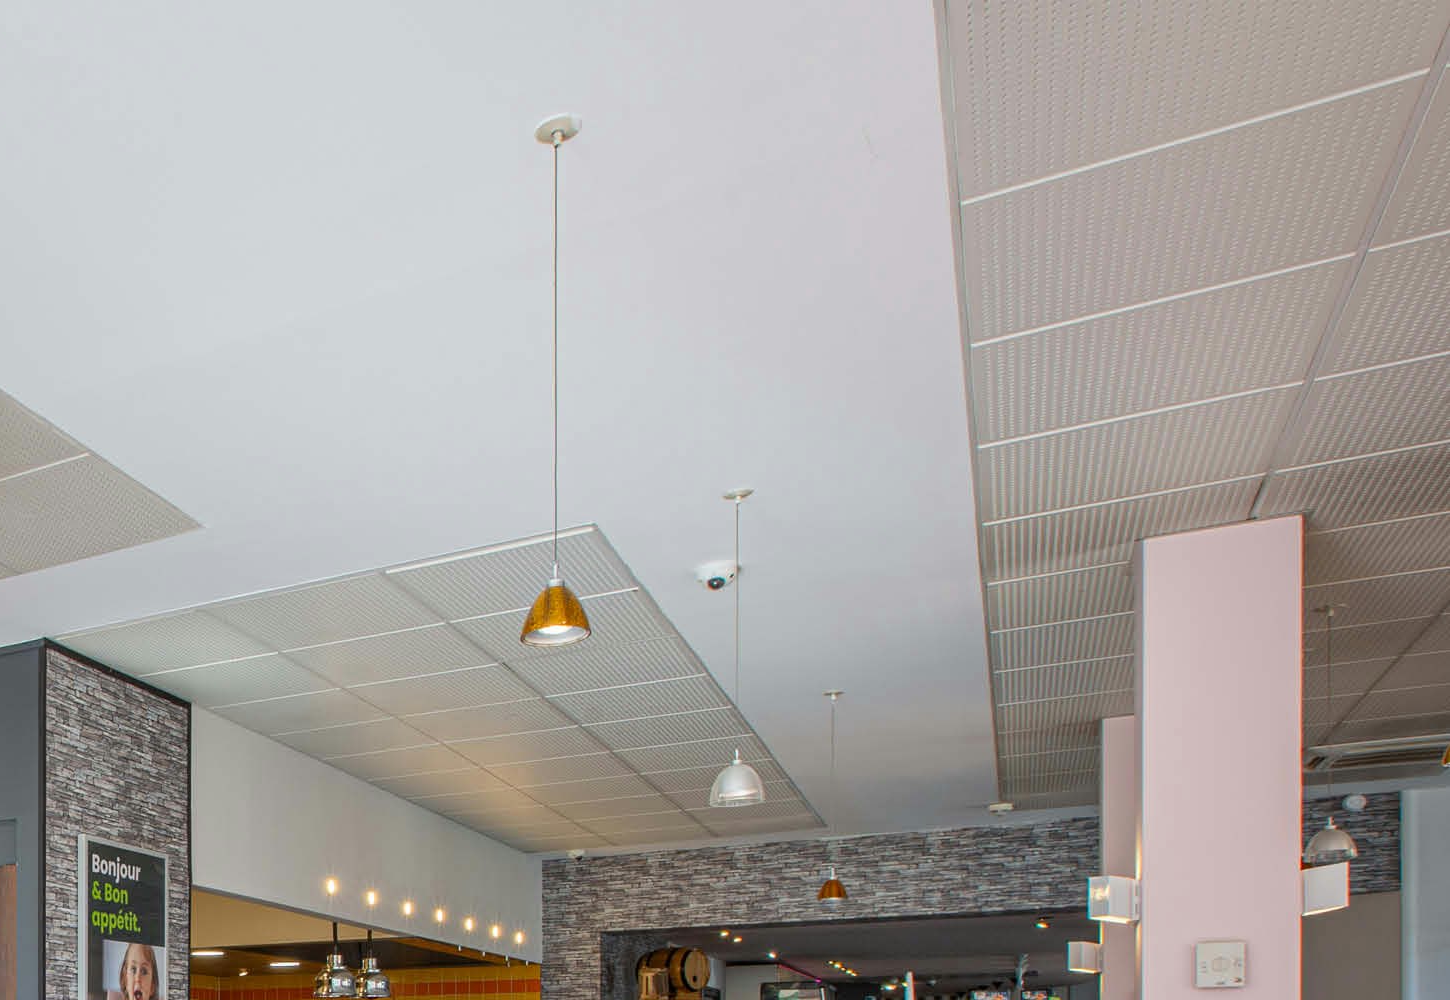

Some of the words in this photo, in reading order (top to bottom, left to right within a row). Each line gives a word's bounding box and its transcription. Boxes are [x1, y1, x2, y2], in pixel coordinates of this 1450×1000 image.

[92, 854, 141, 883] Bonjour
[92, 880, 102, 900] &
[104, 882, 128, 905] Bon
[91, 908, 141, 935] appétit.
